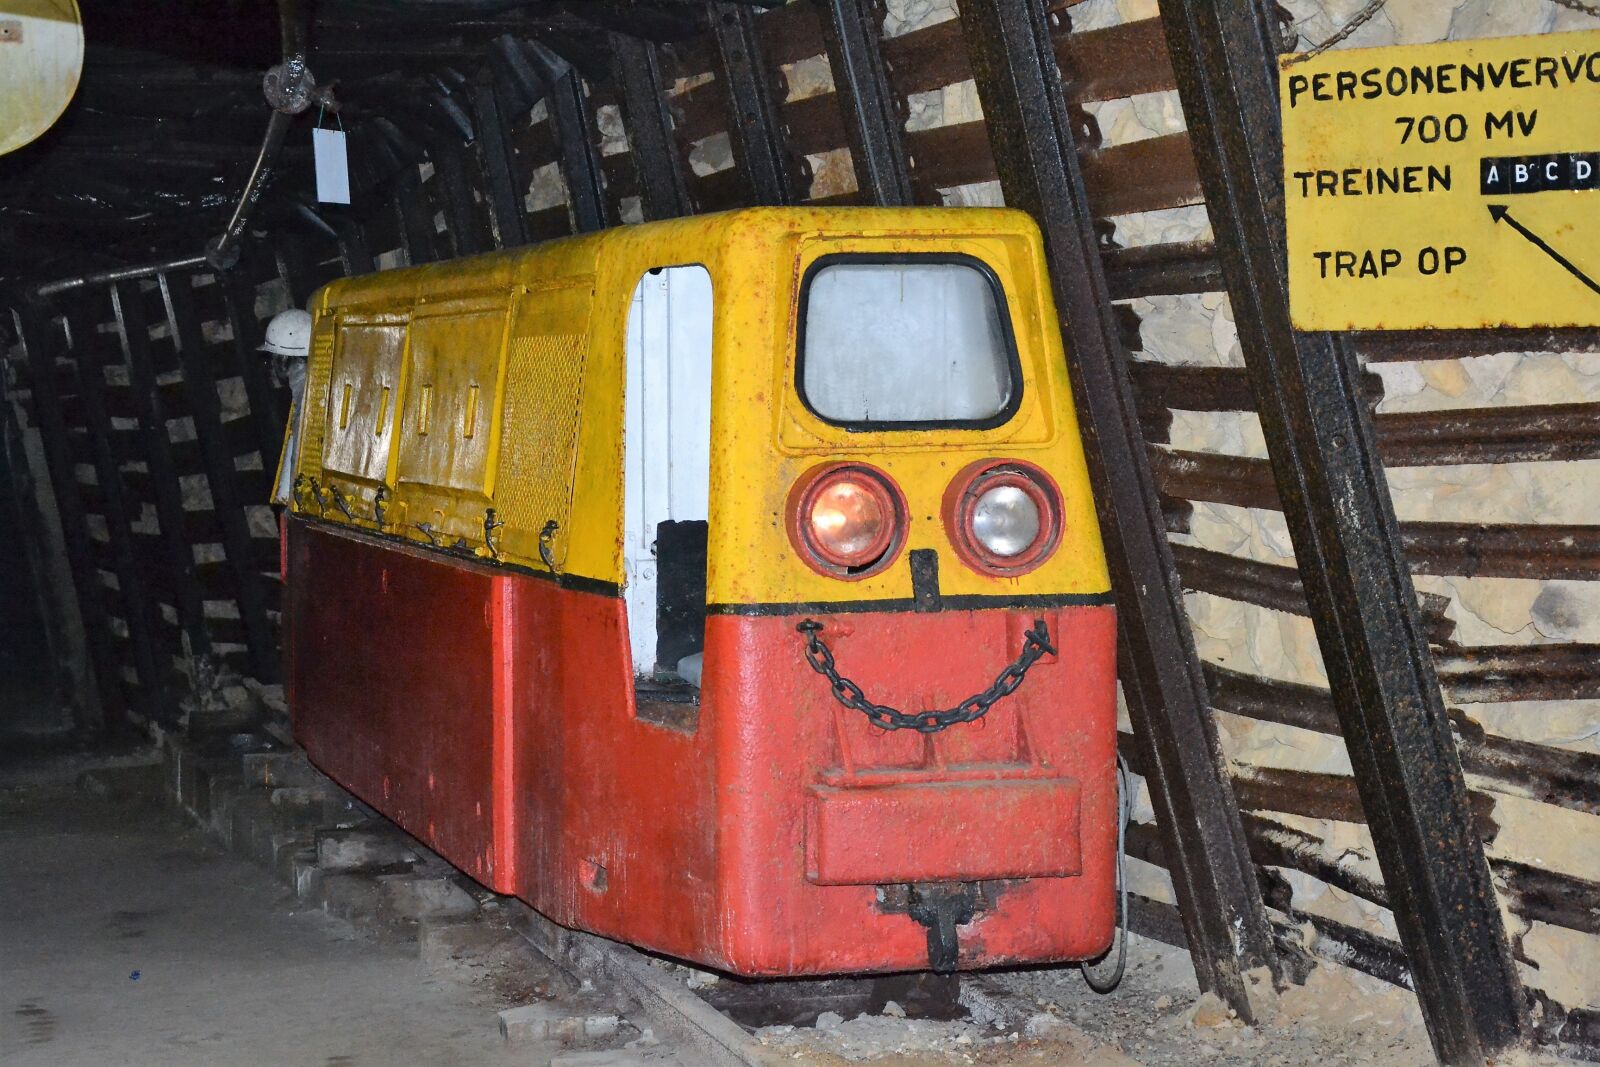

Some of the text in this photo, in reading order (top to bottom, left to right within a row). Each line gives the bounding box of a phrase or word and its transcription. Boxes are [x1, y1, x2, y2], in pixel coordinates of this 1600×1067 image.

[1395, 109, 1537, 144] 700 MV
[1293, 161, 1592, 198] TREINEN A B C D
[1313, 246, 1467, 279] TRAP OP
